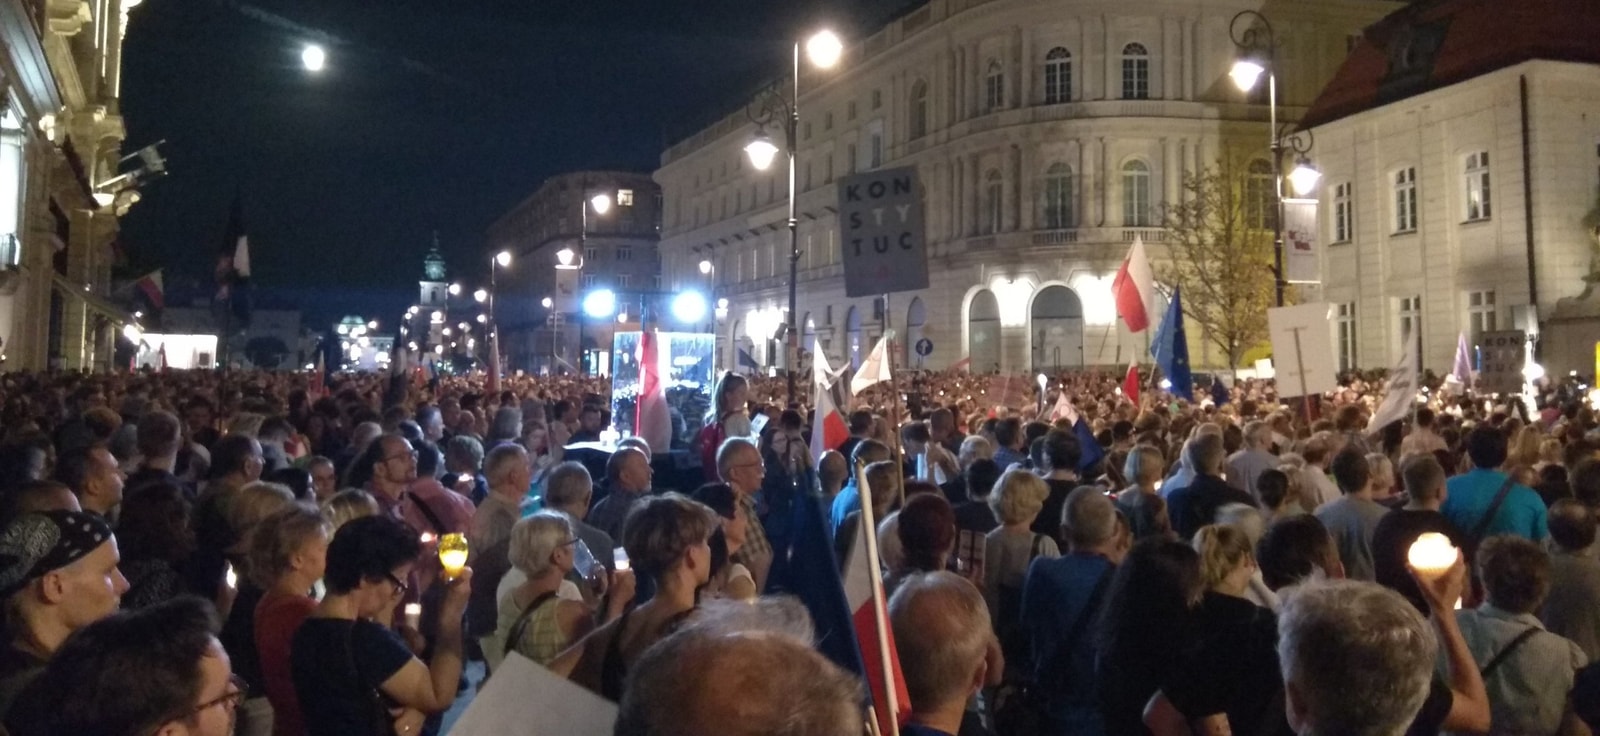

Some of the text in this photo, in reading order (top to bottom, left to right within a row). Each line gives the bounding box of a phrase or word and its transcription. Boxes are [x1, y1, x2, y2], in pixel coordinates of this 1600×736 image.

[847, 176, 911, 202] KON
[850, 204, 911, 229] STY
[851, 232, 913, 257] TUC
